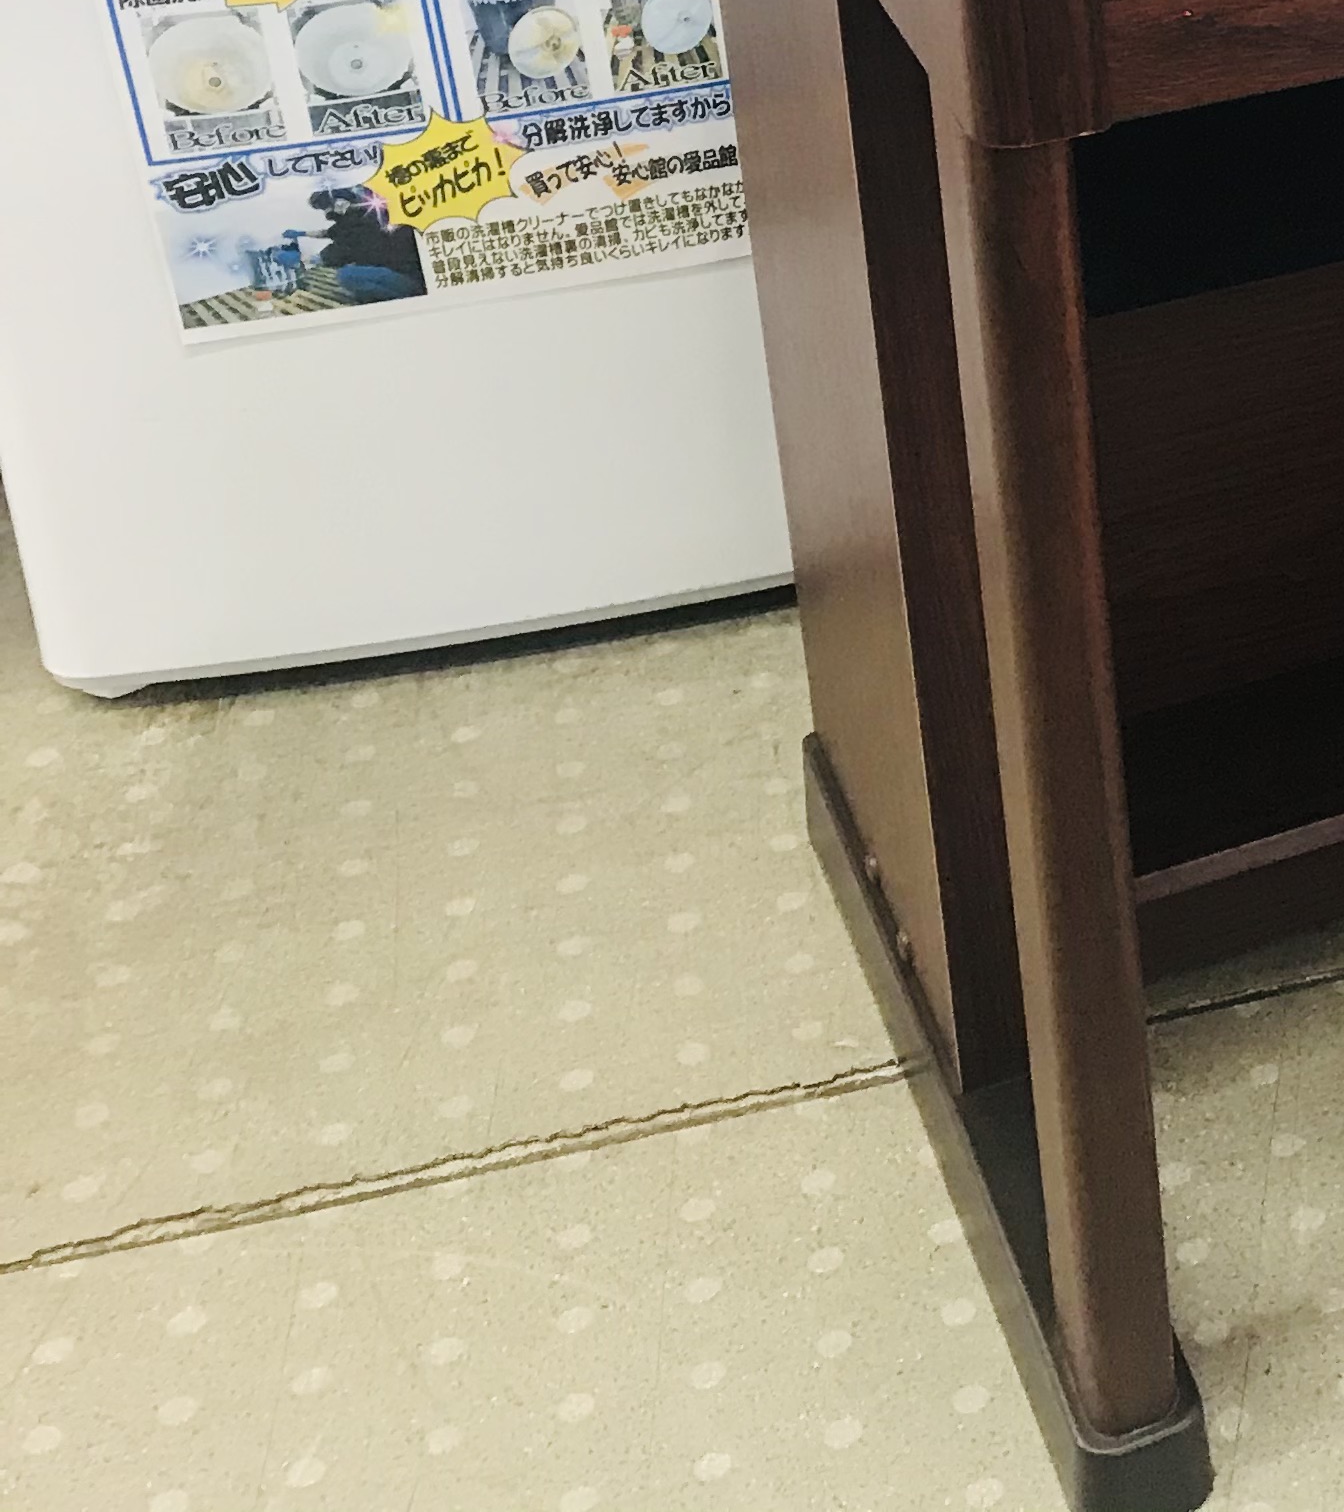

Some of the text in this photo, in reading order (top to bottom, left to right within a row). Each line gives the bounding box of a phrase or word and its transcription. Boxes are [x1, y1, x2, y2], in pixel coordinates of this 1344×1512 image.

[618, 61, 720, 93] After
[481, 84, 594, 114] Before
[316, 104, 425, 134] After
[522, 95, 731, 147] 分解洗浄してますから
[168, 121, 288, 152] Before
[614, 144, 739, 187] 安心館の愛品館
[163, 159, 261, 209] 安心
